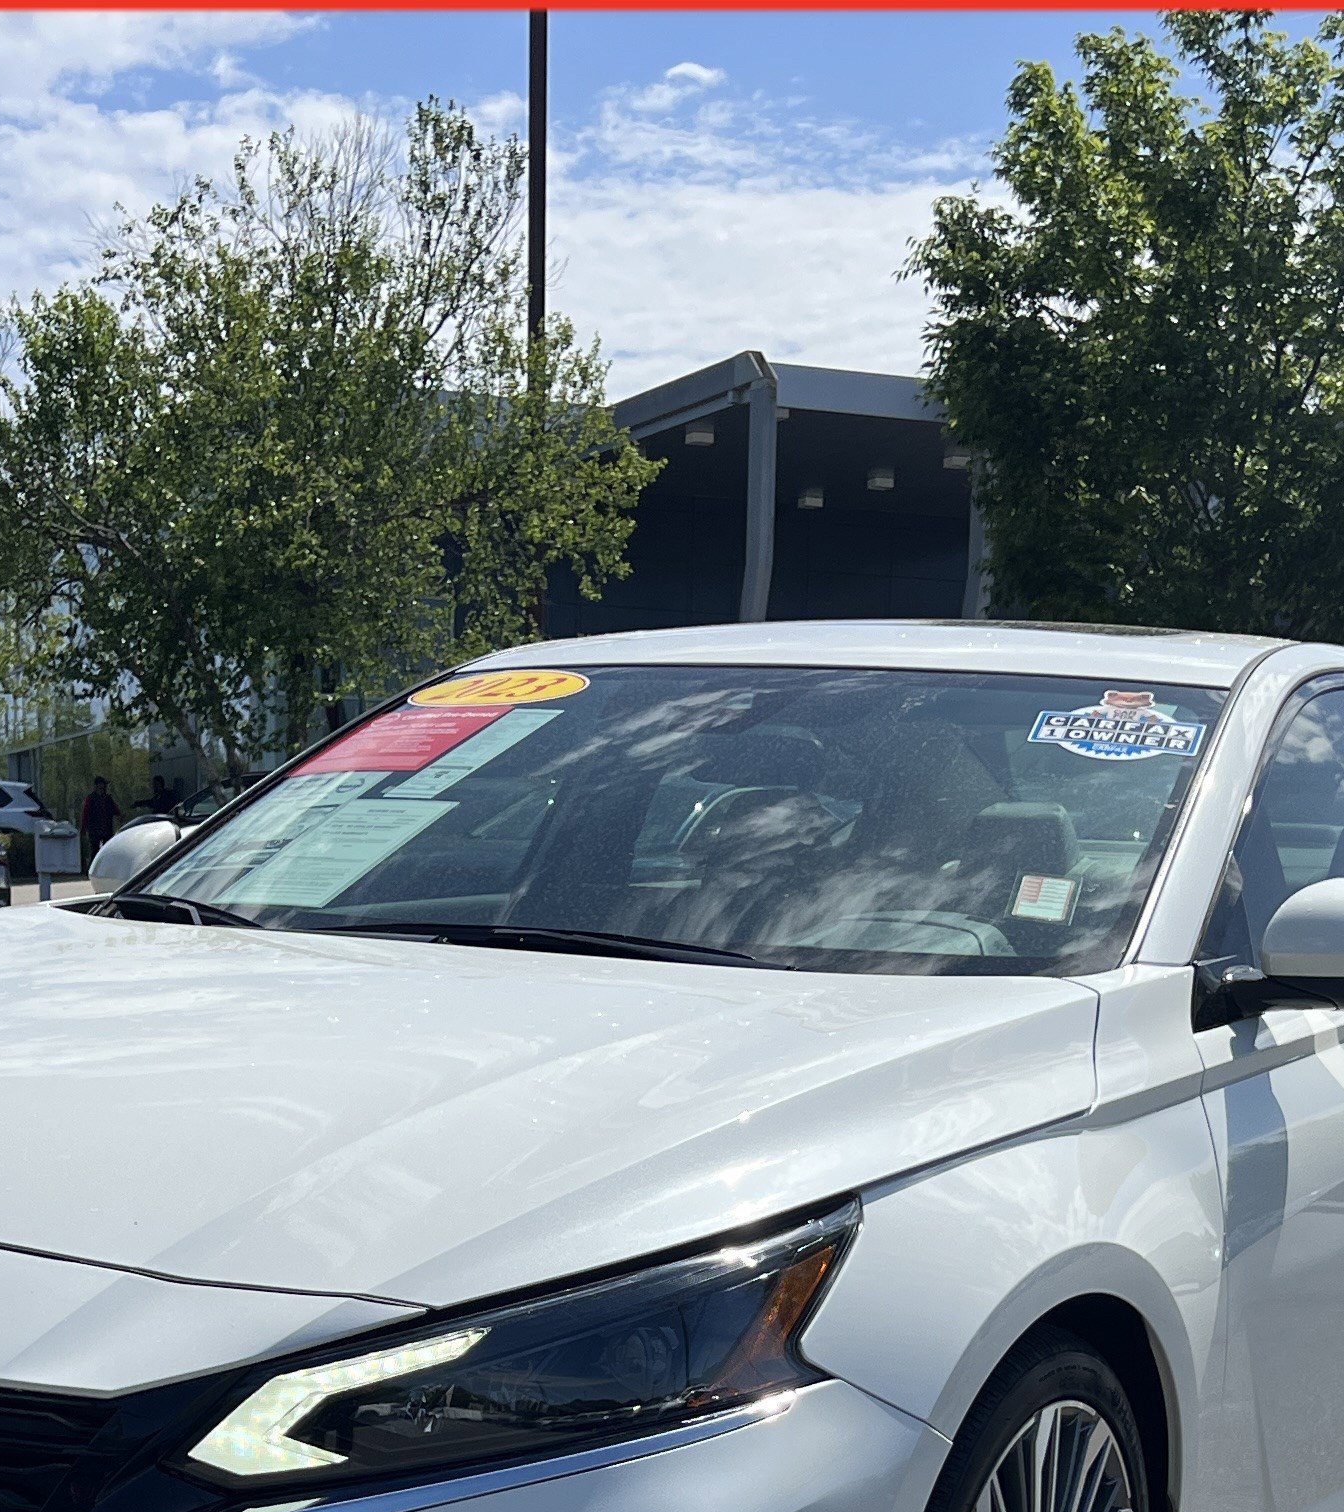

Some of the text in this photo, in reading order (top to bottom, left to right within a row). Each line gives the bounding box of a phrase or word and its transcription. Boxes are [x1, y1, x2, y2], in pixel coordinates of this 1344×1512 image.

[424, 677, 568, 702] 2023
[1046, 727, 1059, 738] 1
[1068, 729, 1186, 750] OWNER
[1048, 715, 1194, 739] CARFAX
